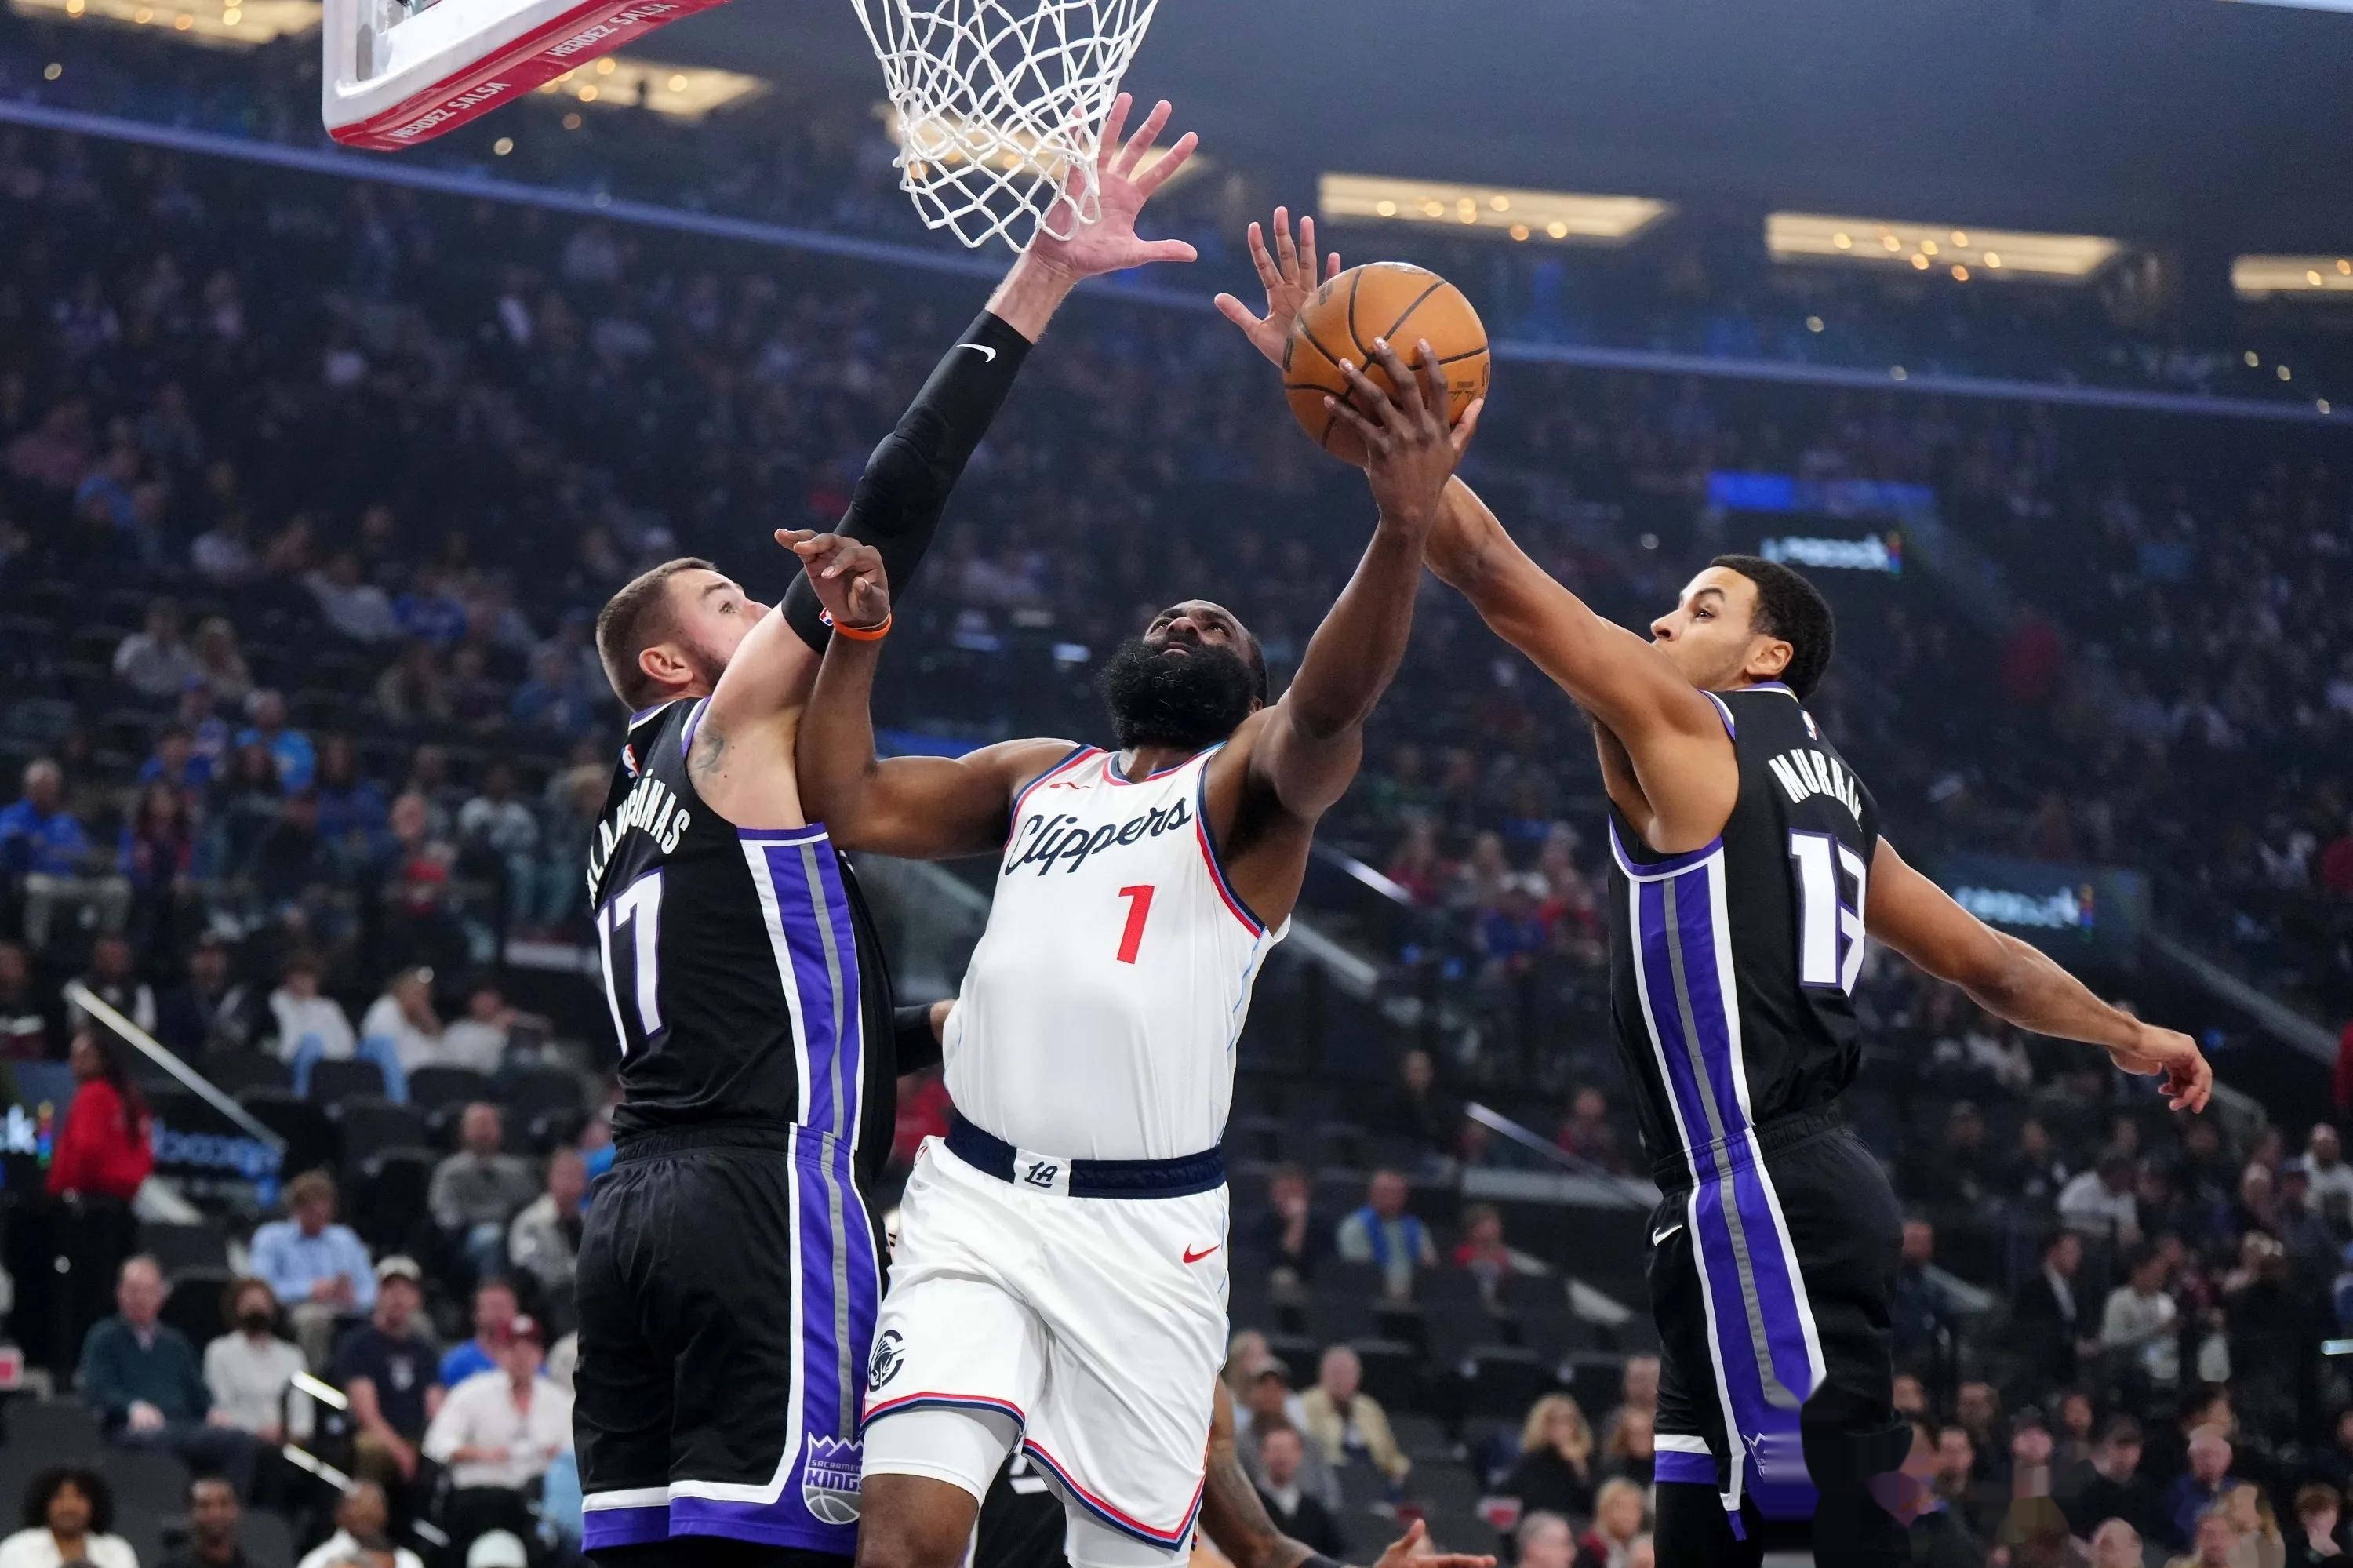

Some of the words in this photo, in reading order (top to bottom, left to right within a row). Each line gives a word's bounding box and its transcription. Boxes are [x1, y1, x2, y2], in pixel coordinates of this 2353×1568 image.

[545, 24, 618, 58] HERDEZ
[611, 2, 680, 26] SALSA
[389, 108, 458, 139] HERDEZ
[449, 81, 512, 111] SALSA
[1005, 796, 1193, 877] Clippers
[1116, 884, 1155, 965] 1
[1789, 828, 1866, 997] 13
[806, 1469, 861, 1493] KING
